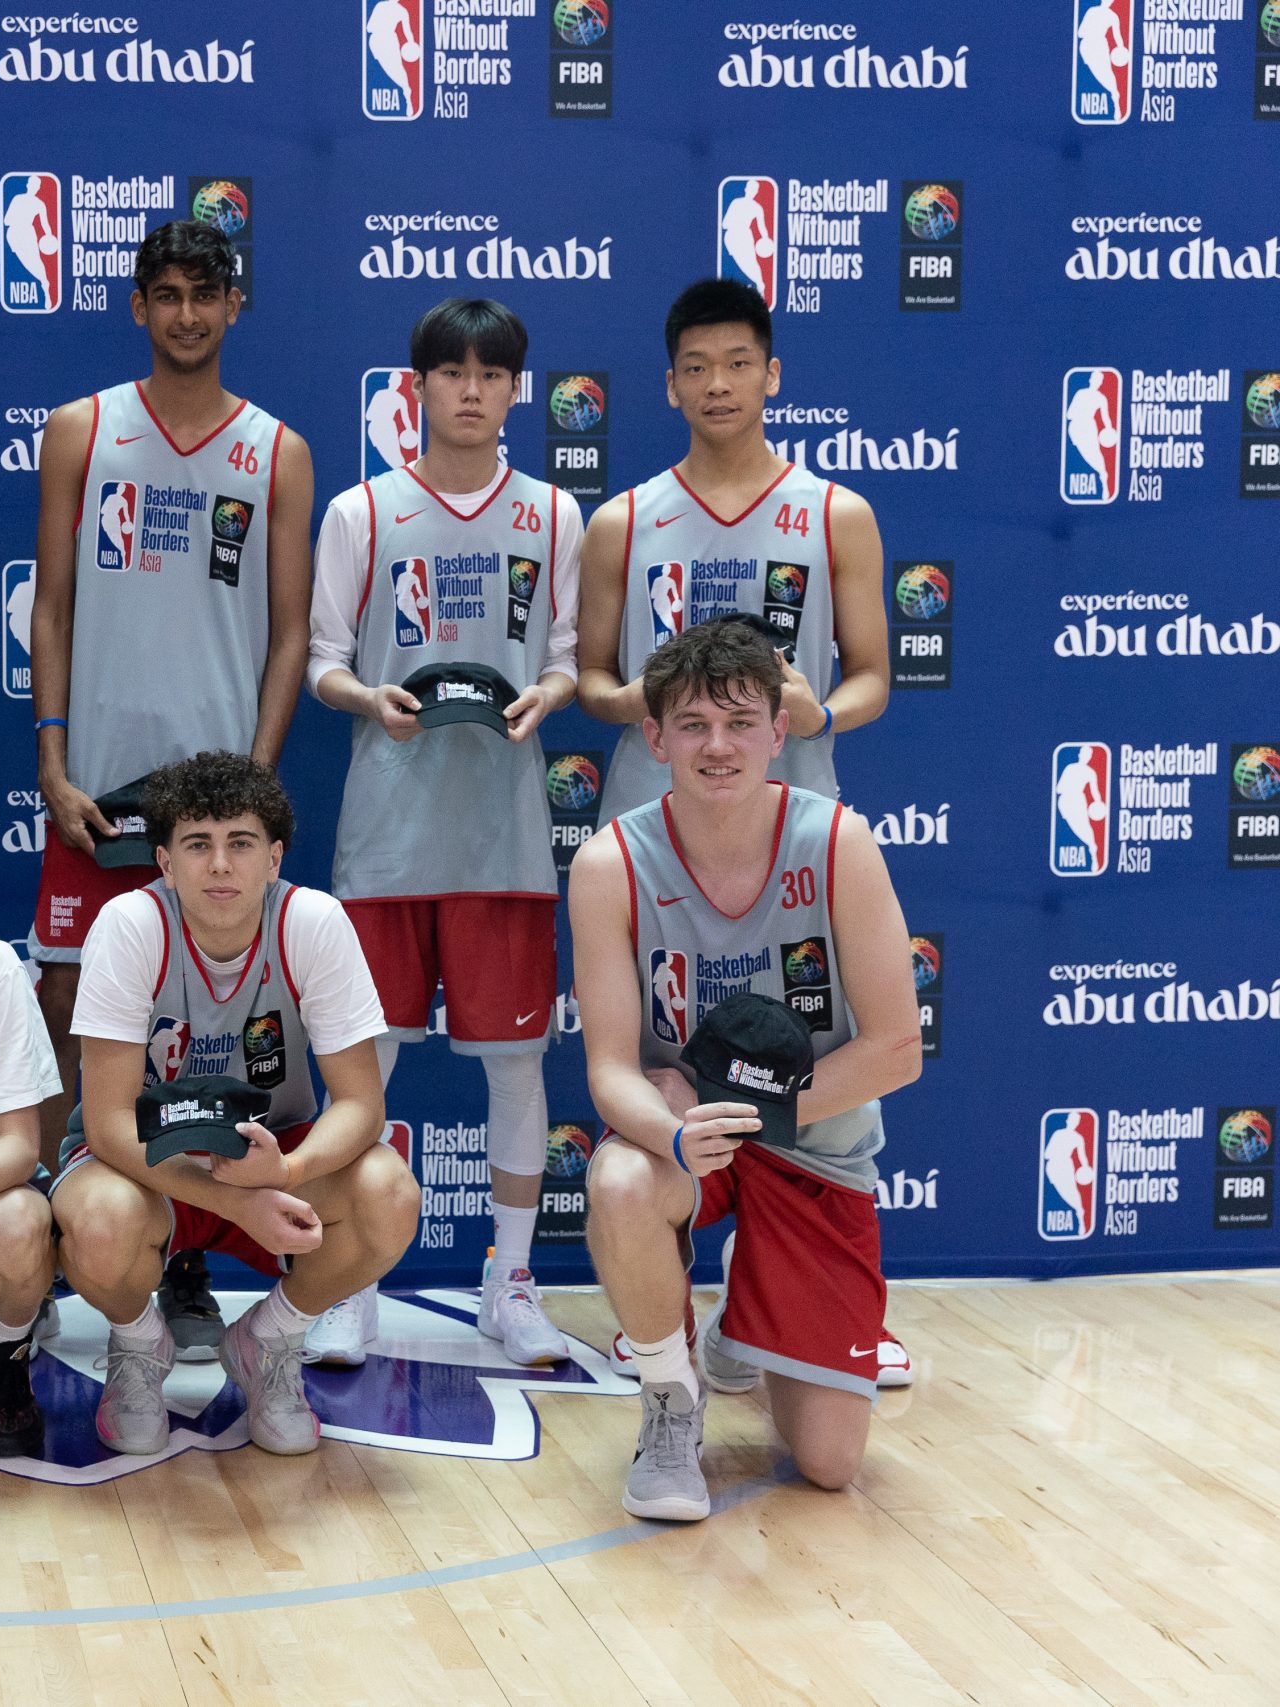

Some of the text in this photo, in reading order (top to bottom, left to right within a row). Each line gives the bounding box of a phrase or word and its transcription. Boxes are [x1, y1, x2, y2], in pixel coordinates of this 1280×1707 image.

[434, 17, 508, 50] Without
[1143, 22, 1215, 54] Without
[434, 51, 511, 84] Borders
[560, 62, 602, 83] FIBA
[719, 45, 814, 87] abu
[1142, 55, 1217, 88] Borders
[372, 89, 399, 110] NBA
[434, 85, 467, 118] Asia
[1081, 93, 1108, 114] NBA
[1141, 89, 1174, 121] Asia
[789, 179, 887, 212] Basketball
[788, 213, 860, 245] Without
[360, 236, 456, 278] abu
[787, 247, 862, 279] Borders
[910, 256, 952, 277] FIBA
[787, 280, 819, 312] Asia
[1132, 369, 1229, 402] Basketball
[1131, 403, 1202, 435] Without
[227, 441, 259, 475] 46
[1130, 436, 1204, 468] Borders
[1070, 474, 1096, 494] NBA
[1129, 470, 1161, 501] Asia
[144, 484, 207, 511] Basketball
[143, 507, 189, 531] Without
[512, 500, 541, 533] 26
[774, 503, 809, 538] 44
[141, 528, 189, 553] Borders
[100, 550, 119, 566] NBA
[138, 550, 162, 573] Asia
[435, 552, 500, 576] Basketball
[691, 558, 757, 580] Basketball
[436, 576, 483, 598] Without
[691, 580, 737, 603] Without
[437, 598, 485, 620] Borders
[770, 611, 795, 630] FIBA
[400, 628, 418, 644] NBA
[436, 620, 458, 642] Asia
[901, 635, 942, 656] FIBA
[780, 866, 816, 909] 30
[51, 895, 82, 906] Basketball
[51, 906, 73, 916] Without
[696, 946, 771, 978] Basketball
[791, 995, 824, 1012] FIBA
[656, 1017, 673, 1039] NBA
[251, 1055, 279, 1076] FIBA
[168, 1099, 199, 1111] Basketball
[190, 1109, 214, 1121] Borders
[1108, 1107, 1203, 1140] Basketball
[1107, 1141, 1176, 1172] Without
[1106, 1173, 1178, 1204] Borders
[1224, 1177, 1264, 1198] FIBA
[1047, 1211, 1073, 1231] NBA
[1105, 1205, 1137, 1234] Asia
